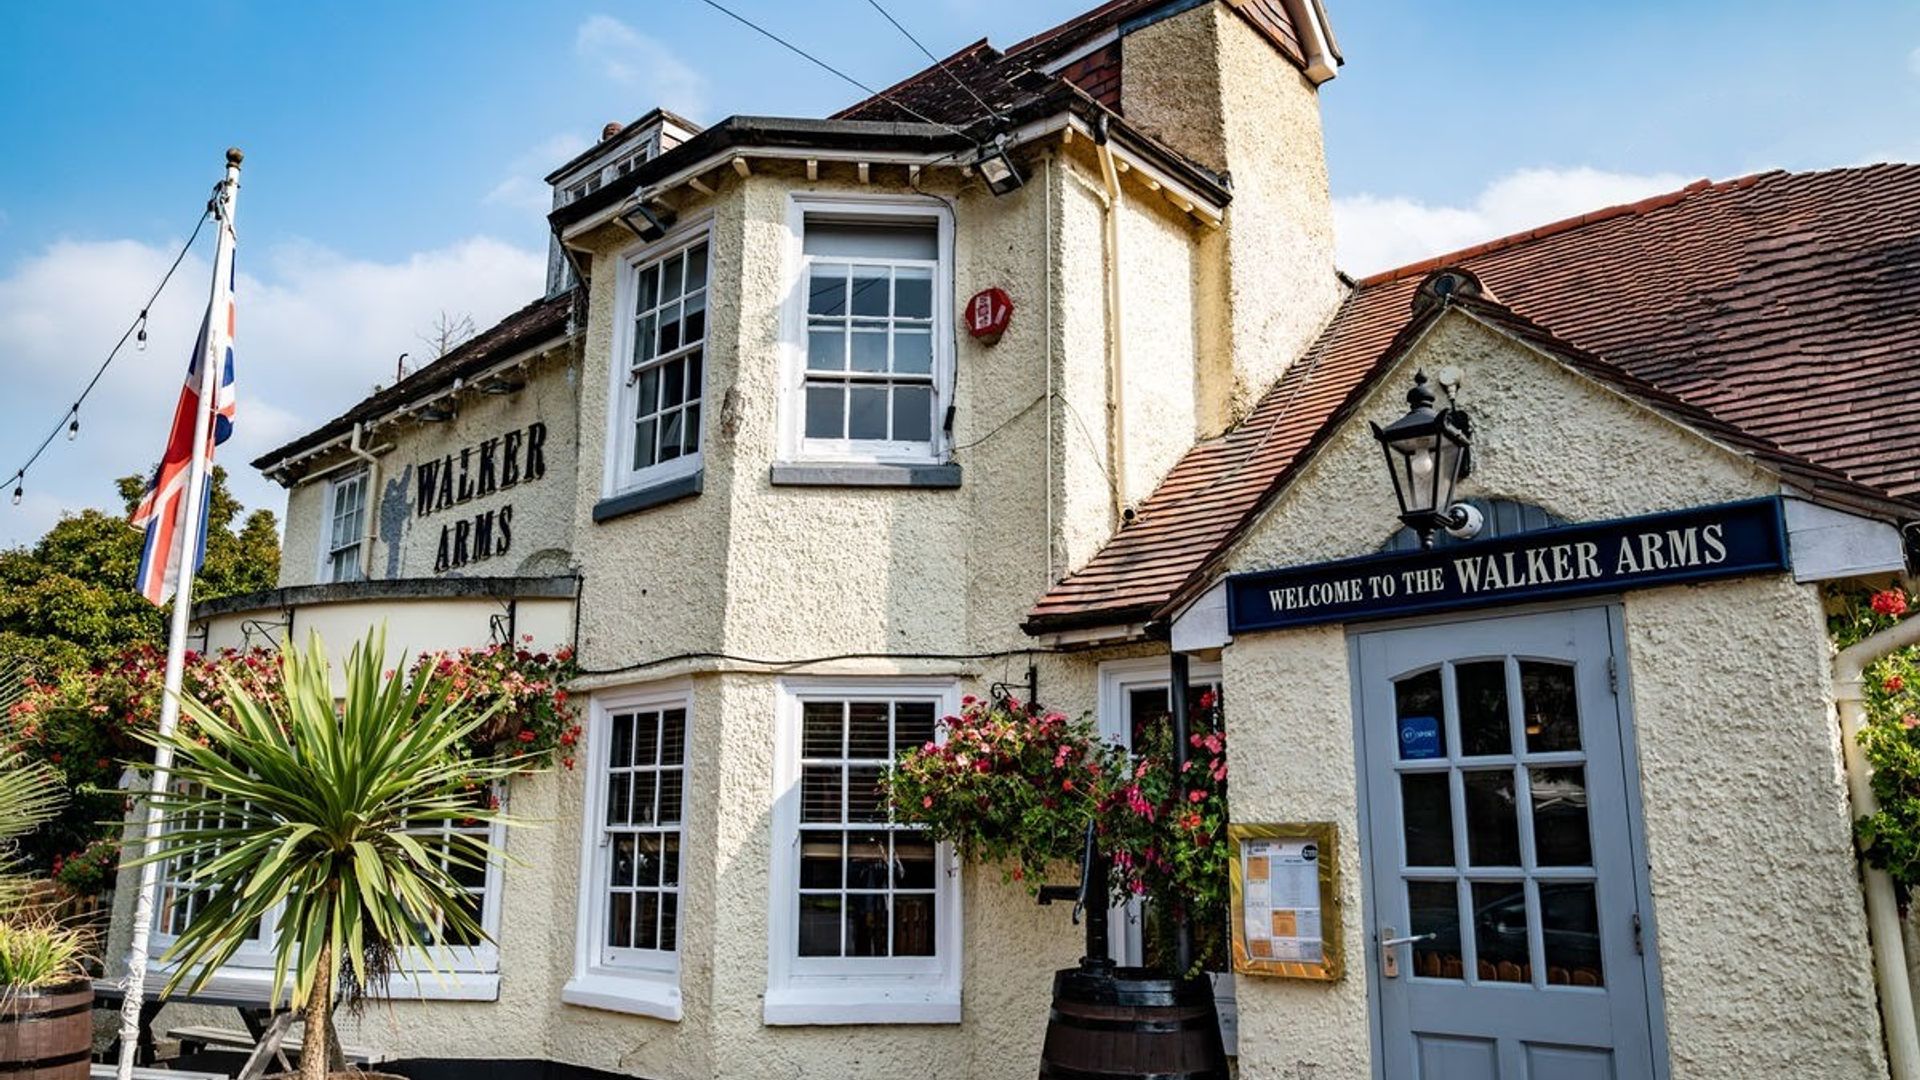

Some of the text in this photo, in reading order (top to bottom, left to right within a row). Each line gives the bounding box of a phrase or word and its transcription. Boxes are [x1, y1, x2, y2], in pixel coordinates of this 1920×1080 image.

[417, 422, 547, 518] WALKER
[434, 503, 513, 574] ARMS
[1269, 524, 1728, 612] WELCOME TO THE WALKER ARMS
